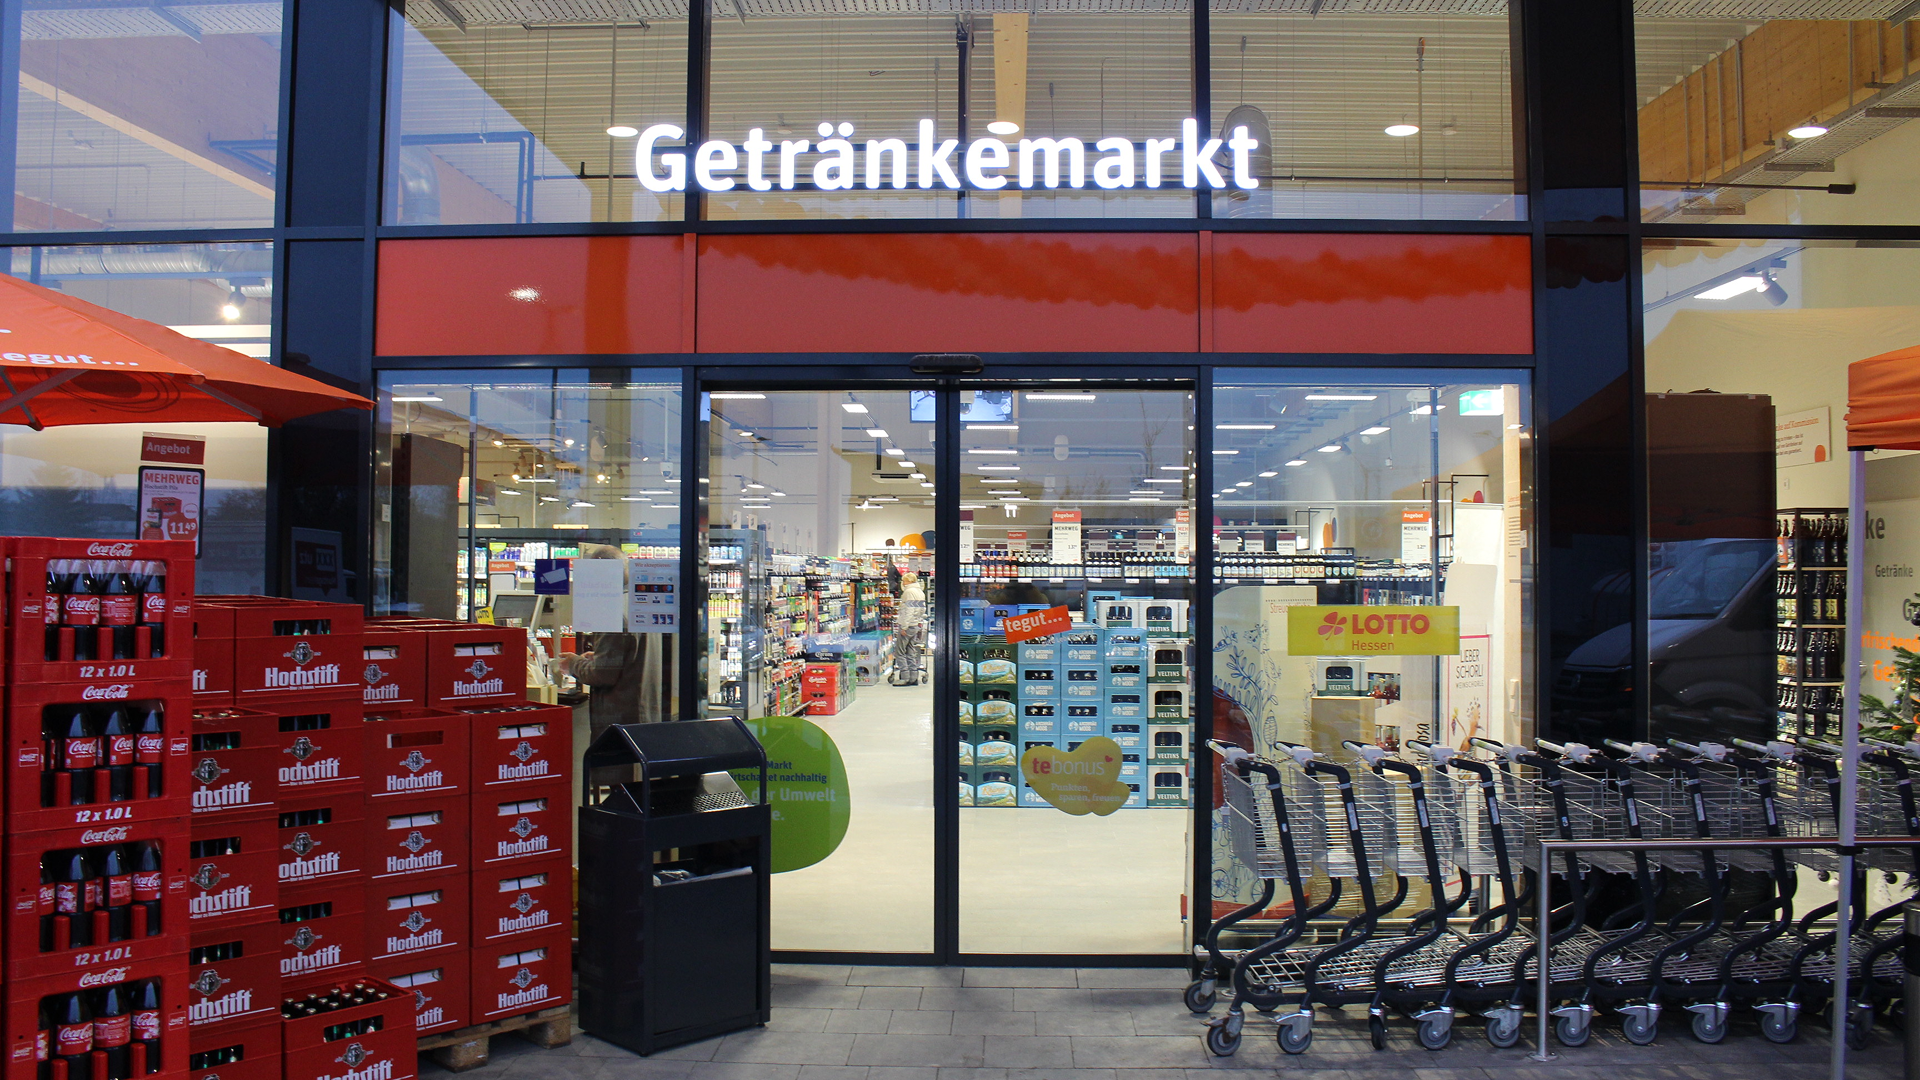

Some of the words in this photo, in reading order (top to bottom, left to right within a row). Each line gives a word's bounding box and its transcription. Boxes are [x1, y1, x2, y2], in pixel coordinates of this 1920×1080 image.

[634, 118, 1260, 193] Getränkemarkt
[0, 352, 139, 366] egut...
[146, 442, 191, 455] Angebot
[144, 472, 200, 485] MEHRWEG
[87, 542, 134, 557] Coca-Cola
[1875, 564, 1914, 578] Getränke
[1005, 612, 1063, 633] tegut...
[1352, 613, 1430, 635] LOTTO
[1351, 640, 1395, 651] Hessen
[1460, 649, 1480, 663] LIEBER
[80, 666, 93, 678] 12
[96, 667, 104, 677] x
[109, 665, 126, 677] 1.0
[128, 665, 136, 677] L
[265, 663, 340, 687] Hochstift
[82, 684, 130, 700] Coca-Cola
[453, 678, 504, 695] Hochstift
[498, 759, 549, 780] Hochstift
[767, 761, 793, 769] Markt
[1032, 755, 1105, 775] tebonus
[386, 770, 443, 791] Hochstift
[780, 773, 828, 784] nachhaltig
[751, 787, 775, 801] dr
[780, 787, 836, 802] Umwelt
[75, 811, 91, 823] 12
[92, 811, 101, 821] x
[105, 807, 123, 820] 1.0
[125, 807, 133, 818] L
[81, 826, 128, 845] Coca-Cola
[497, 835, 548, 857] Hochstift
[386, 850, 443, 872] Hochstift
[498, 909, 549, 933] Hochstift
[386, 928, 443, 953] Hochstift
[75, 954, 90, 966] 12
[91, 953, 101, 963] x
[104, 949, 123, 962] 1.0
[124, 947, 132, 958] L
[79, 968, 127, 988] Coca-Cola
[498, 984, 548, 1009] Hochstift
